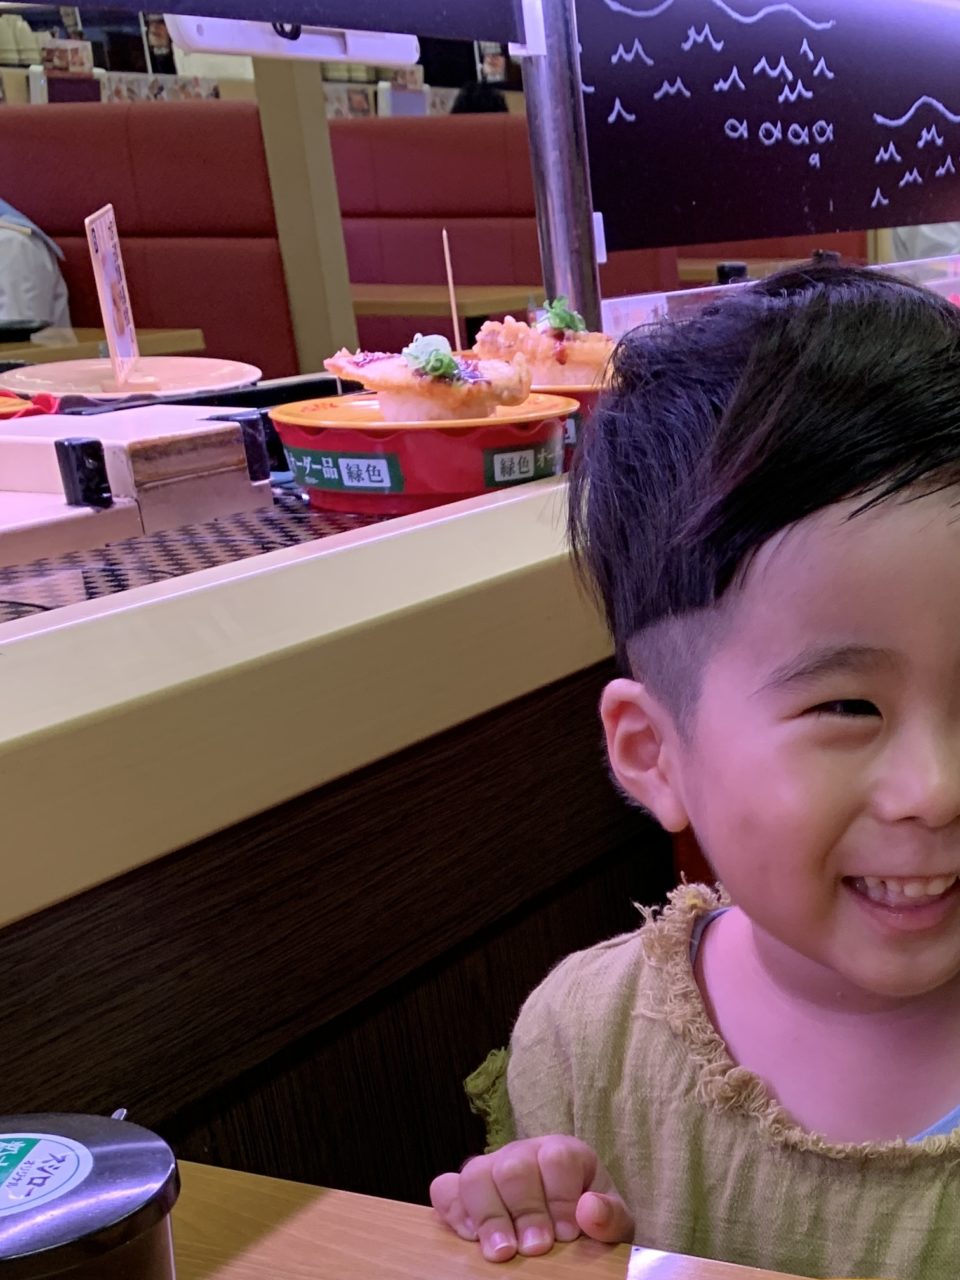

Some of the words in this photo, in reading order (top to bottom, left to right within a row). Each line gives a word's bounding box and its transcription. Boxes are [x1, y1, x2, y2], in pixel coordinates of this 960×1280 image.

[345, 462, 385, 484] 緑色
[499, 454, 531, 478] 緑色
[24, 1152, 69, 1198] スシロー
